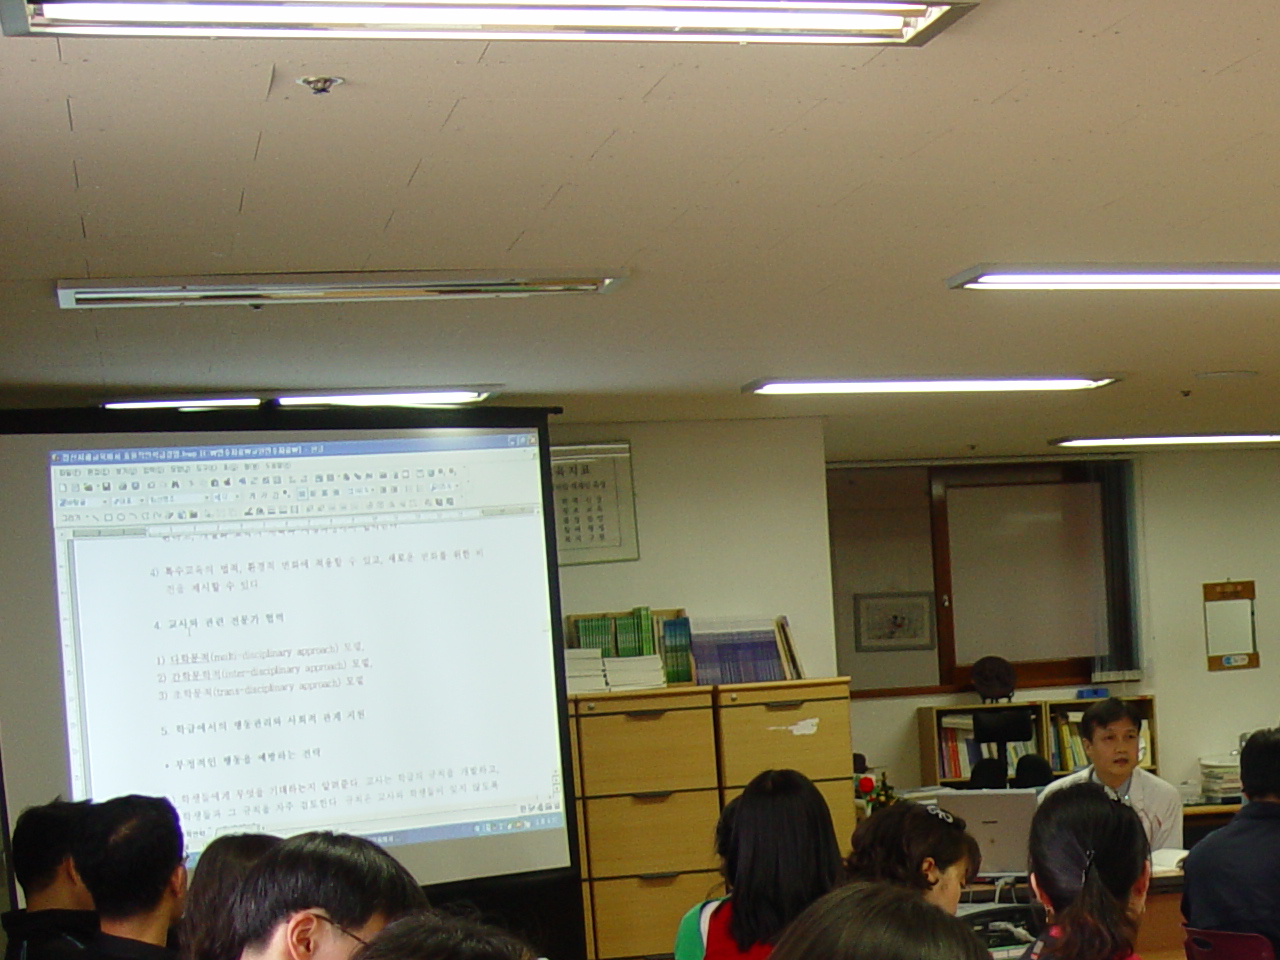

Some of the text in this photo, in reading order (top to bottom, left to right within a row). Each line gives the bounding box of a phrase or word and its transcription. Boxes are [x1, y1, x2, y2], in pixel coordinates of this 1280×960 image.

[157, 655, 165, 666] 1)
[157, 672, 167, 683] 2)
[158, 690, 168, 701] 3)
